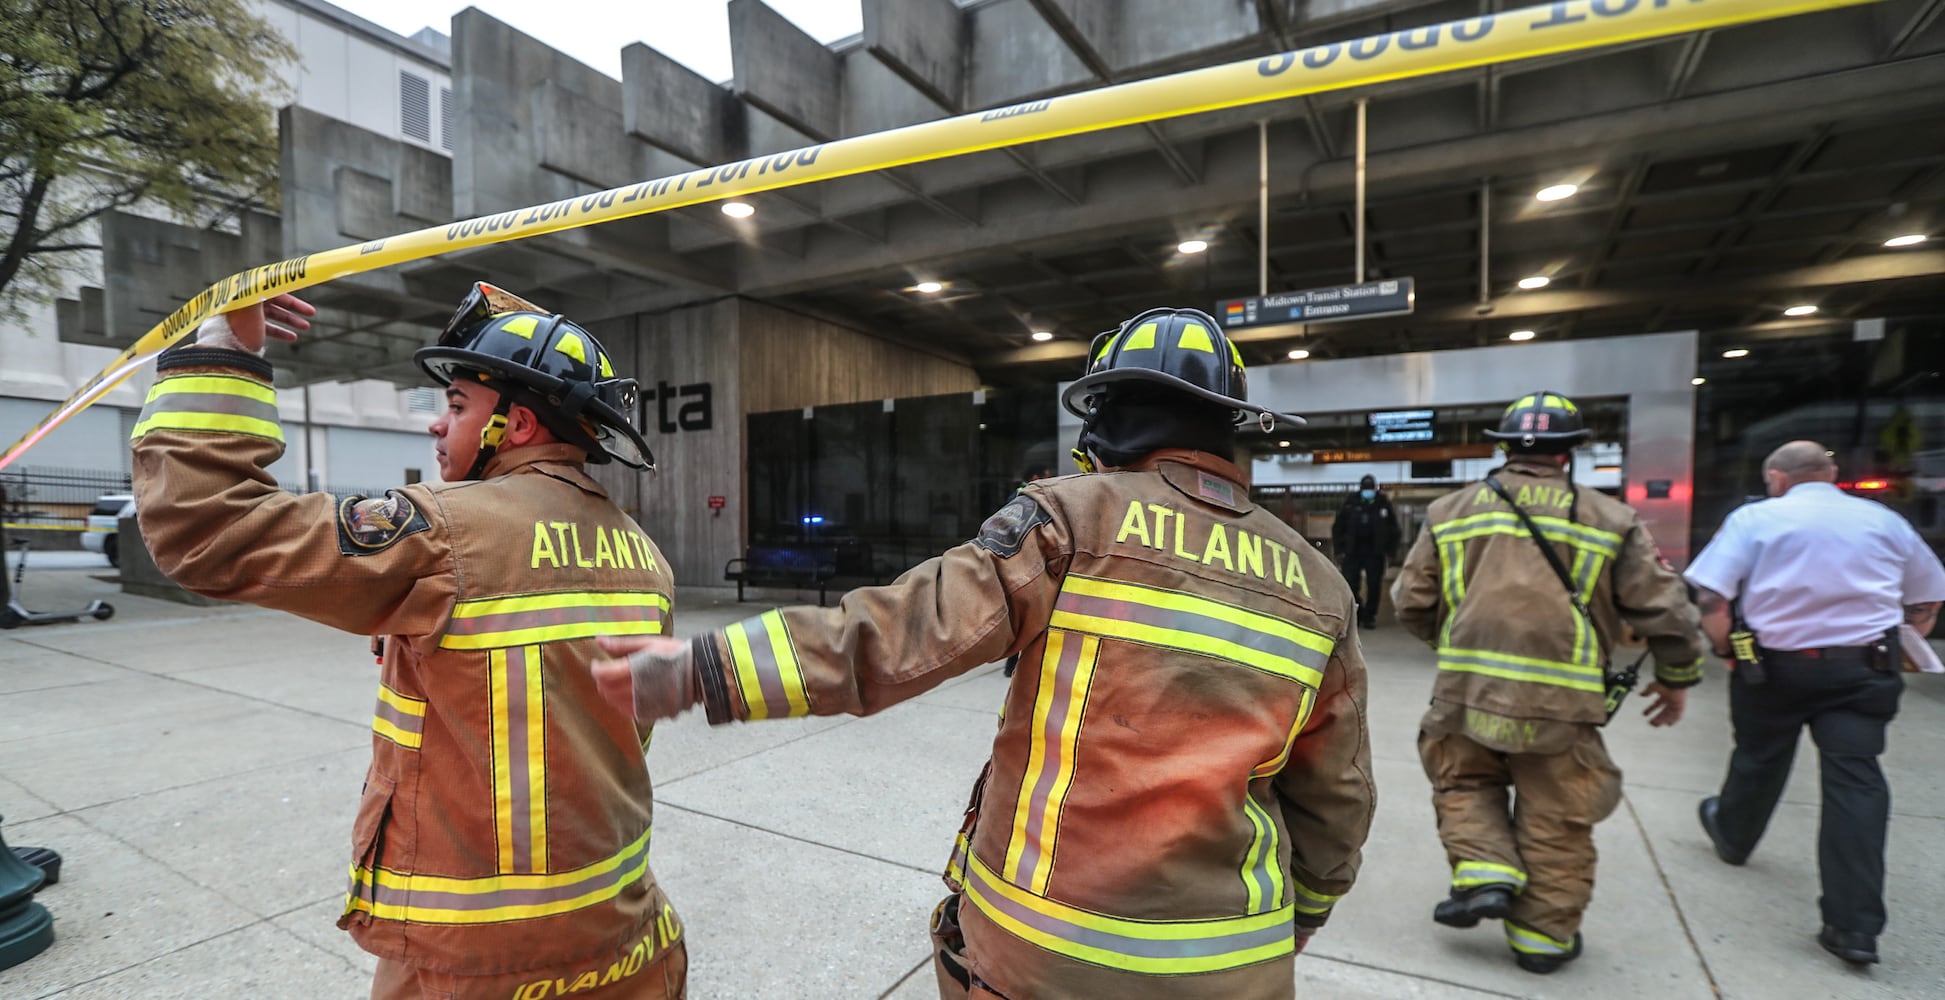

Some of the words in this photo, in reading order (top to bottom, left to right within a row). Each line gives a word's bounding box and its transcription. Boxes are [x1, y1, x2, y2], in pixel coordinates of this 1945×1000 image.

[1263, 294, 1306, 309] Midtown
[1306, 290, 1341, 303] Transit
[1342, 286, 1378, 298] Station
[1304, 303, 1350, 317] Entrance
[641, 381, 713, 436] rta
[531, 520, 661, 575] ATLANTA
[1115, 500, 1311, 598] ATLANTA
